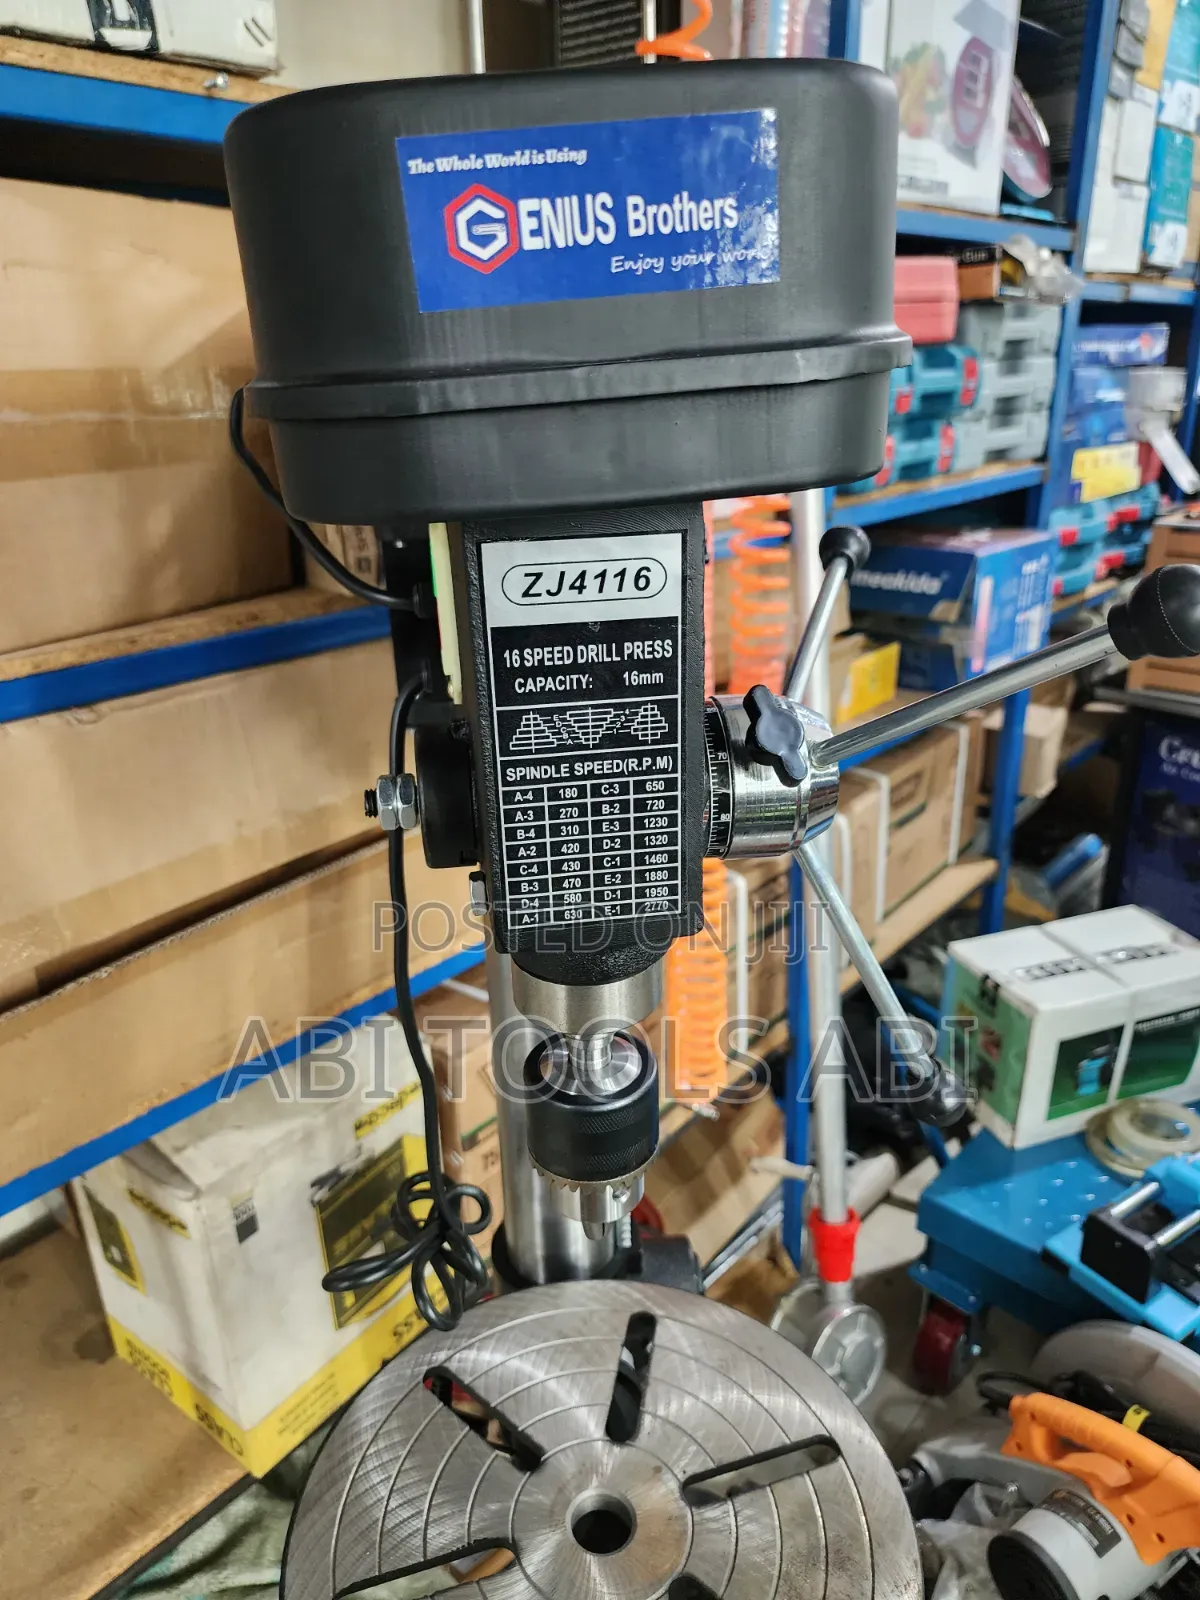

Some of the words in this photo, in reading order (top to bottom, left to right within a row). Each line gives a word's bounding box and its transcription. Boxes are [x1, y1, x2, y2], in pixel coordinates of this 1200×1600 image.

[407, 157, 434, 175] The
[435, 153, 483, 173] Whole
[484, 150, 530, 169] World
[531, 149, 545, 165] is
[545, 147, 588, 166] Using
[626, 190, 739, 238] Brothers
[610, 253, 664, 275] Enjoy
[671, 251, 716, 272] your
[521, 566, 652, 599] ZJ4116
[503, 649, 520, 668] 16
[523, 646, 573, 667] SPEED
[577, 643, 621, 664] DRILL
[623, 639, 673, 661] PRESS
[514, 673, 593, 694] CAPACITY:
[623, 671, 664, 687] 16mm
[717, 752, 728, 761] 70
[506, 762, 570, 782] SPINDLE
[514, 790, 534, 803] A-4
[558, 787, 578, 800] 180
[601, 784, 620, 796] C-3
[645, 780, 665, 792] 650
[515, 809, 534, 822] A-3
[559, 807, 579, 820] 270
[601, 802, 620, 815] B-2
[645, 799, 665, 811] 720
[720, 813, 731, 821] 80
[516, 828, 536, 840] B-4
[560, 824, 580, 837] 310
[602, 820, 620, 832] E-3
[643, 816, 668, 829] 1230
[518, 845, 537, 858] A-2
[561, 842, 580, 855] 420
[603, 837, 621, 850] D-2
[643, 834, 669, 846] 1320
[519, 864, 539, 876] C-4
[561, 860, 581, 872] 430
[603, 856, 621, 868] C-1
[644, 852, 669, 865] 1460
[520, 881, 539, 893] B-3
[562, 877, 582, 890] 470
[604, 873, 622, 886] E-2
[644, 869, 669, 882] 1880
[522, 898, 540, 910] D-4
[563, 893, 582, 904] 580
[604, 889, 621, 901] D-1
[644, 886, 669, 898] 1950
[522, 914, 540, 925] A-1
[564, 910, 583, 921] 630
[604, 905, 621, 916] E-1
[644, 901, 669, 912] 2770
